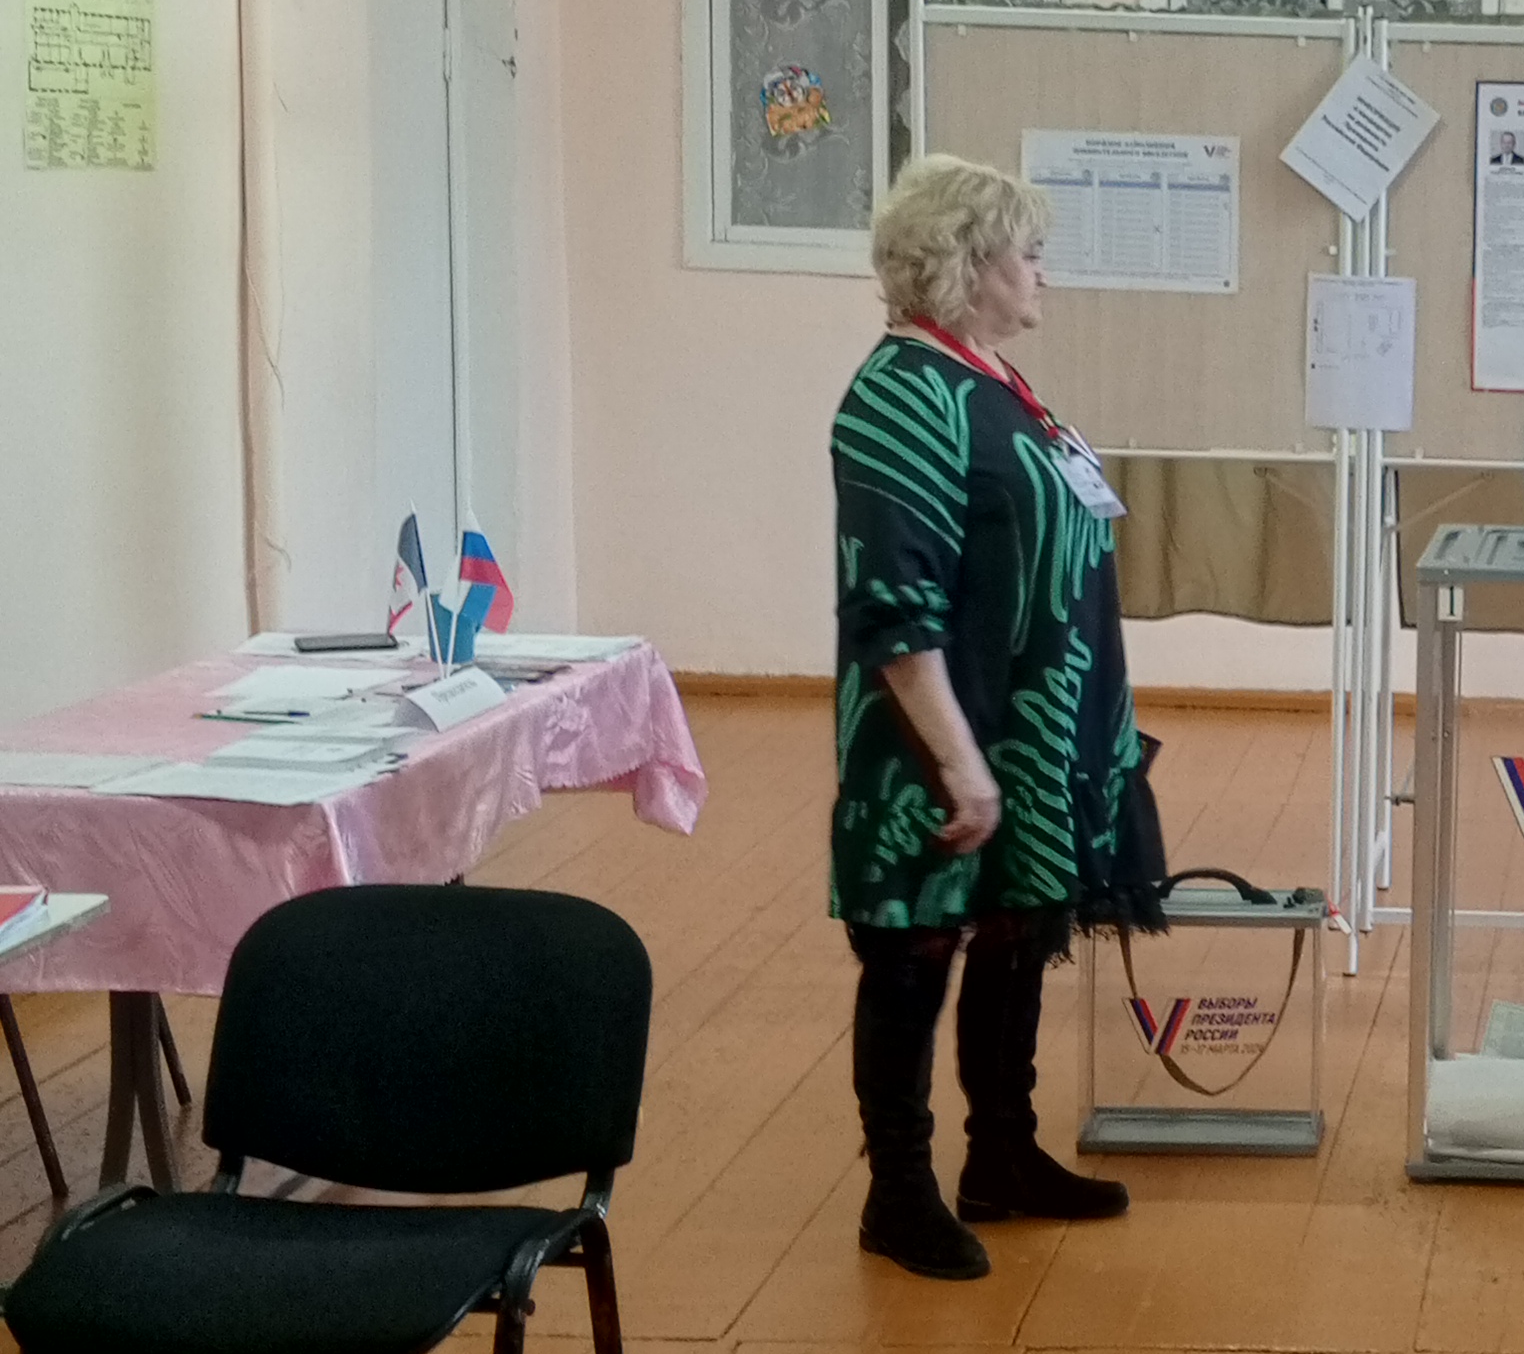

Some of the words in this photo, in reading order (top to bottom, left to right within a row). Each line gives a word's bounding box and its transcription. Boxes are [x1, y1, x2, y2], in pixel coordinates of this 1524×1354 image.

[1198, 997, 1258, 1010] ВЫБОРЫ
[1191, 1012, 1276, 1026] ПРЕЗИДЕНТА
[1184, 1029, 1239, 1041] РОССИИ
